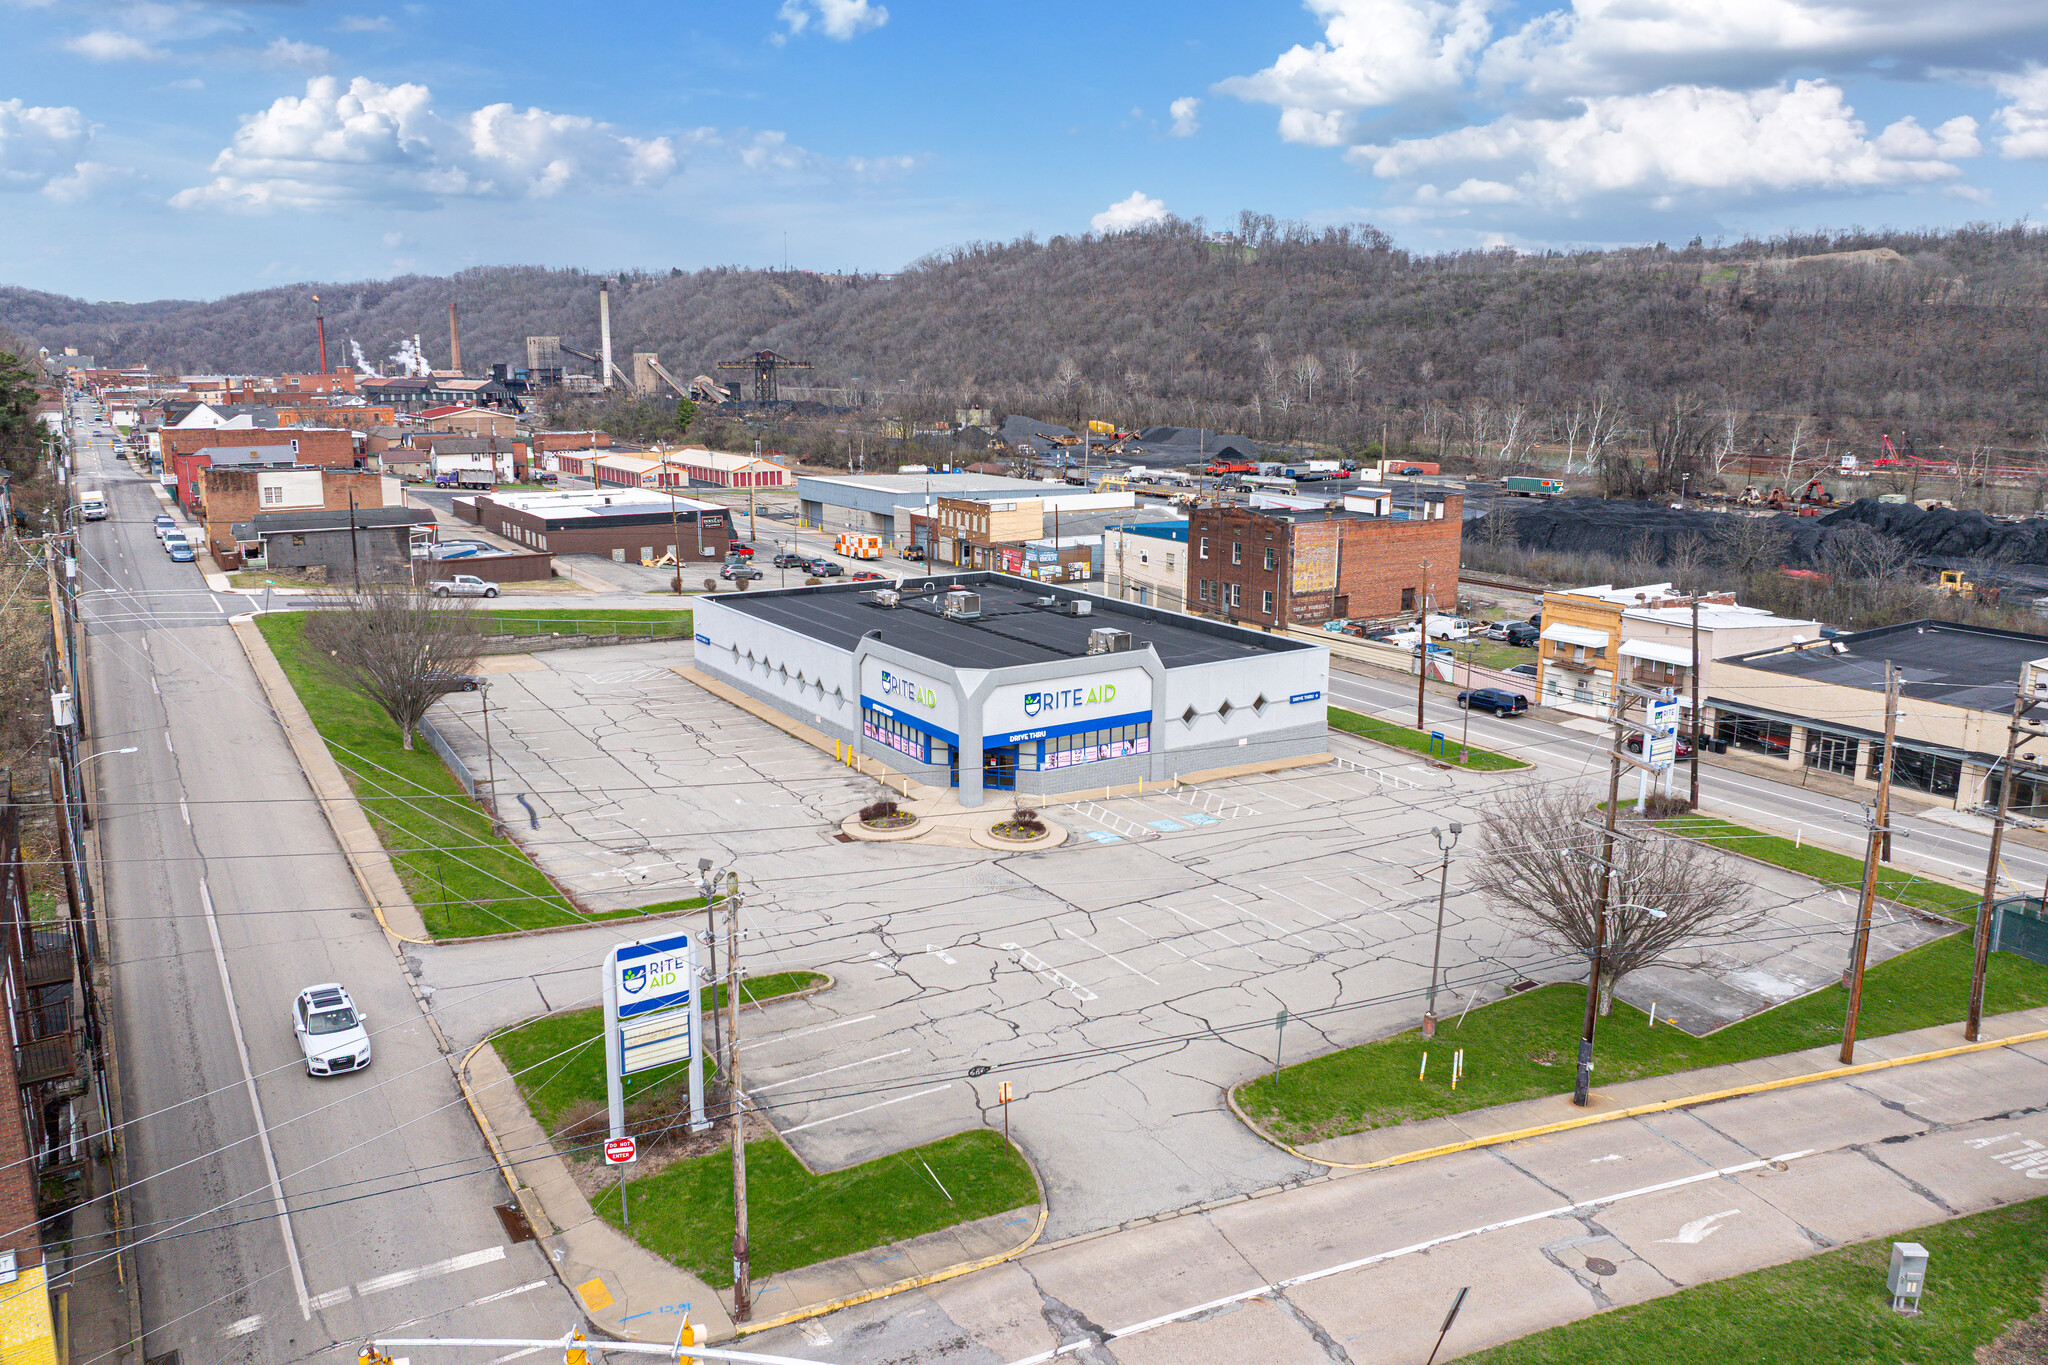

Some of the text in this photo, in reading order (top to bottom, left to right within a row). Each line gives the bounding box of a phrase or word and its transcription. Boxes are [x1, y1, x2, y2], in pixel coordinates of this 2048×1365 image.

[892, 676, 935, 708] RITE AID
[1043, 684, 1116, 711] RITE AID
[1663, 708, 1675, 717] RITE
[1009, 730, 1047, 743] DRIVE THRU
[650, 957, 684, 975] RITE
[650, 972, 676, 989] AID
